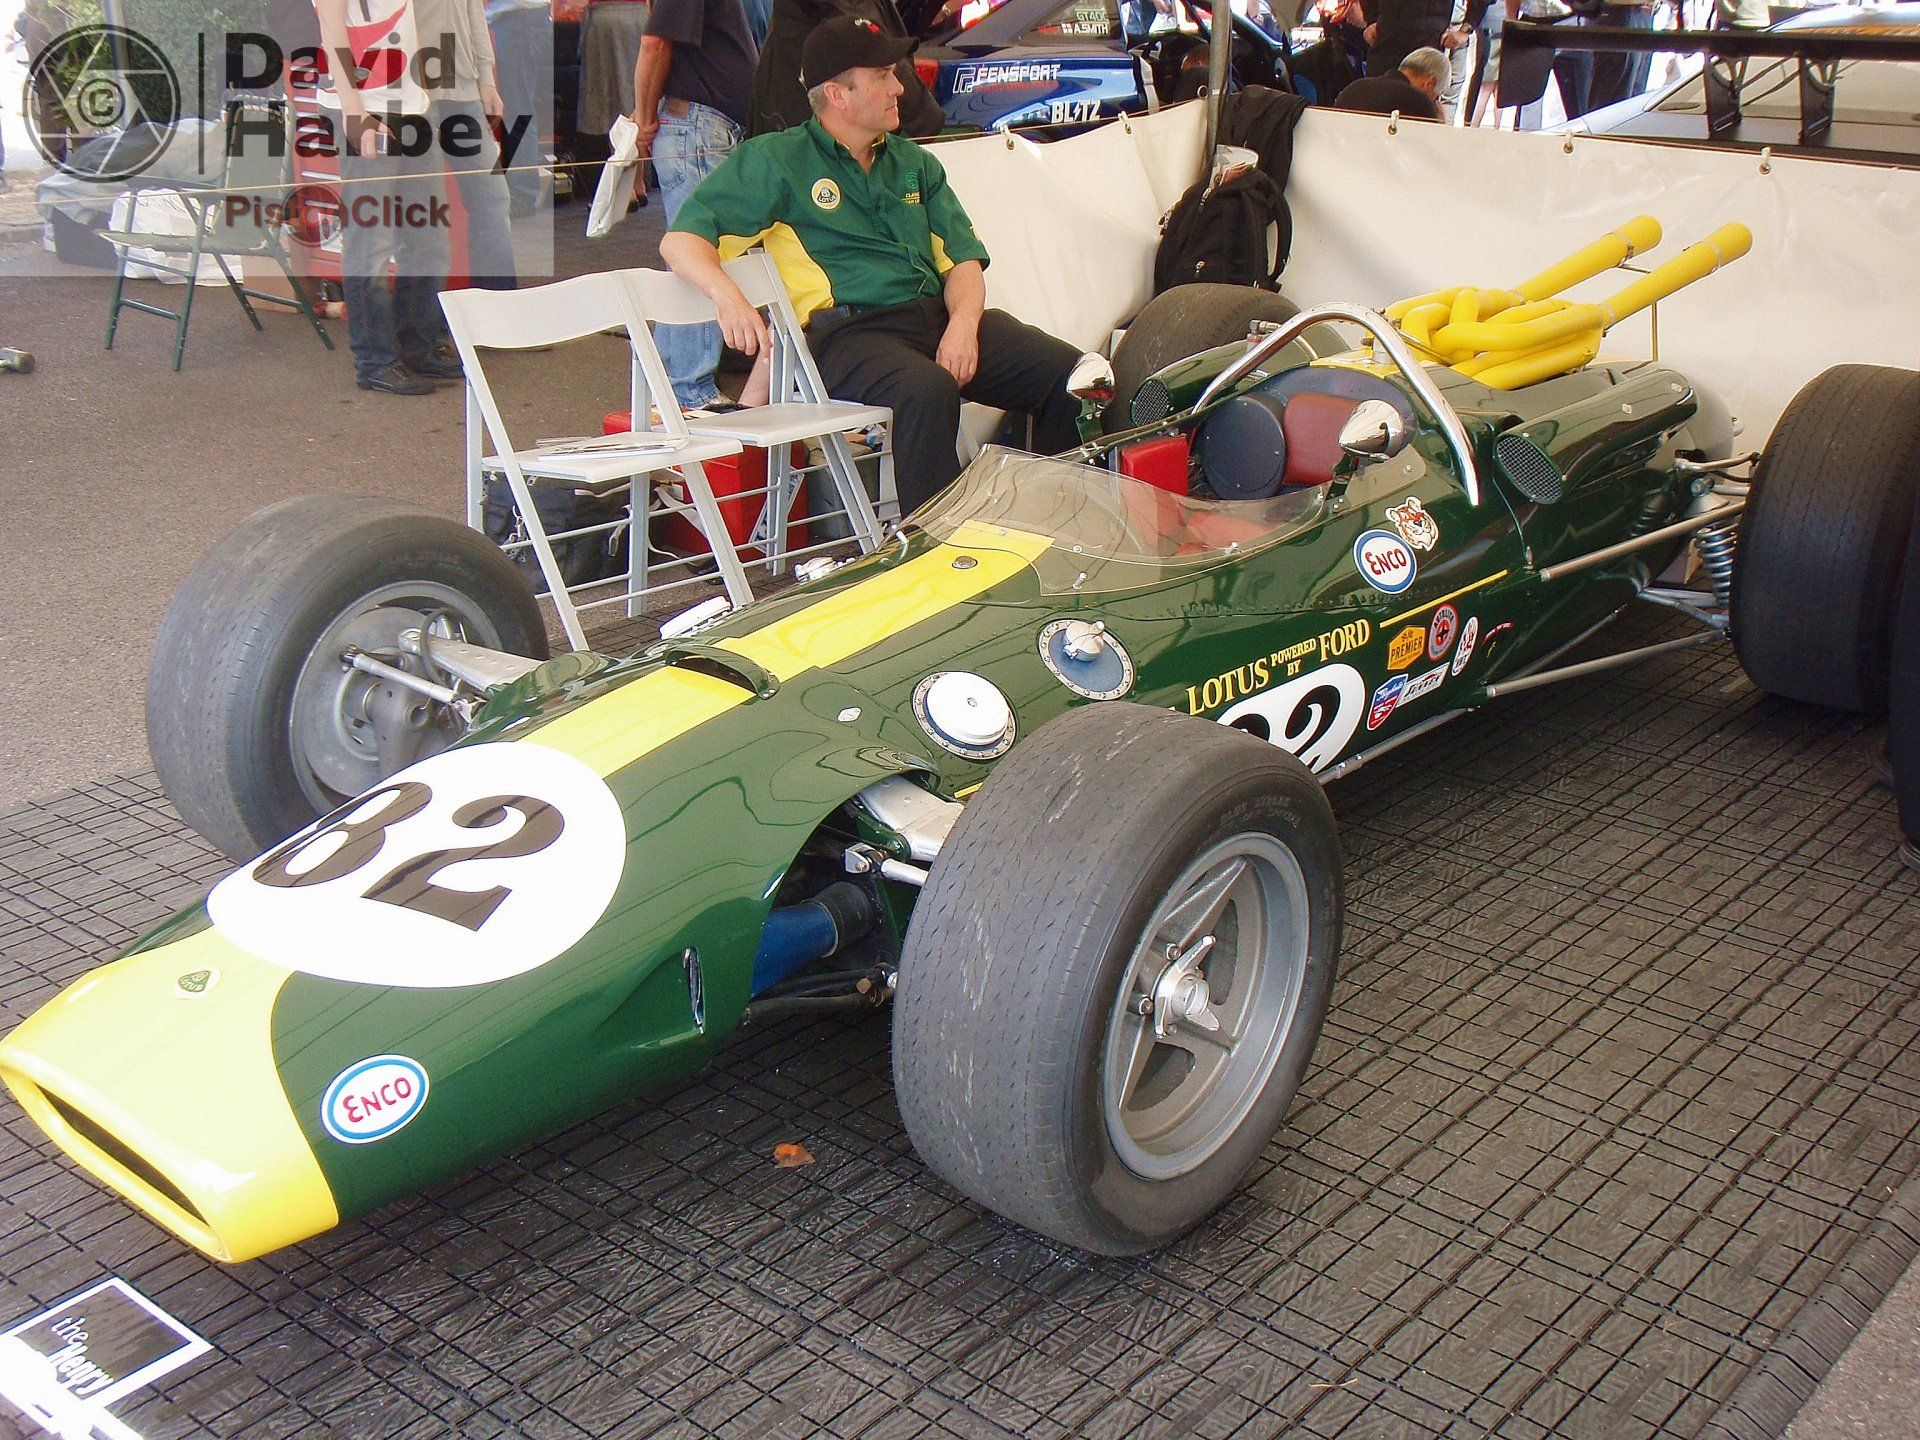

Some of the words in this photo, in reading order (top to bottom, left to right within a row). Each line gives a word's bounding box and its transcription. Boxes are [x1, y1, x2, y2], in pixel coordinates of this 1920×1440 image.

[1051, 100, 1101, 123] BLITZ
[1364, 548, 1407, 575] ENCO
[1270, 638, 1317, 667] POWERED
[1317, 618, 1371, 662] FORD
[1390, 636, 1423, 661] PREMIER
[1287, 659, 1301, 677] BY
[1185, 657, 1270, 716] LOTUS
[252, 781, 565, 932] 82
[342, 1077, 412, 1123] ENCO
[51, 1317, 90, 1345] the
[47, 1341, 114, 1395] Henry
